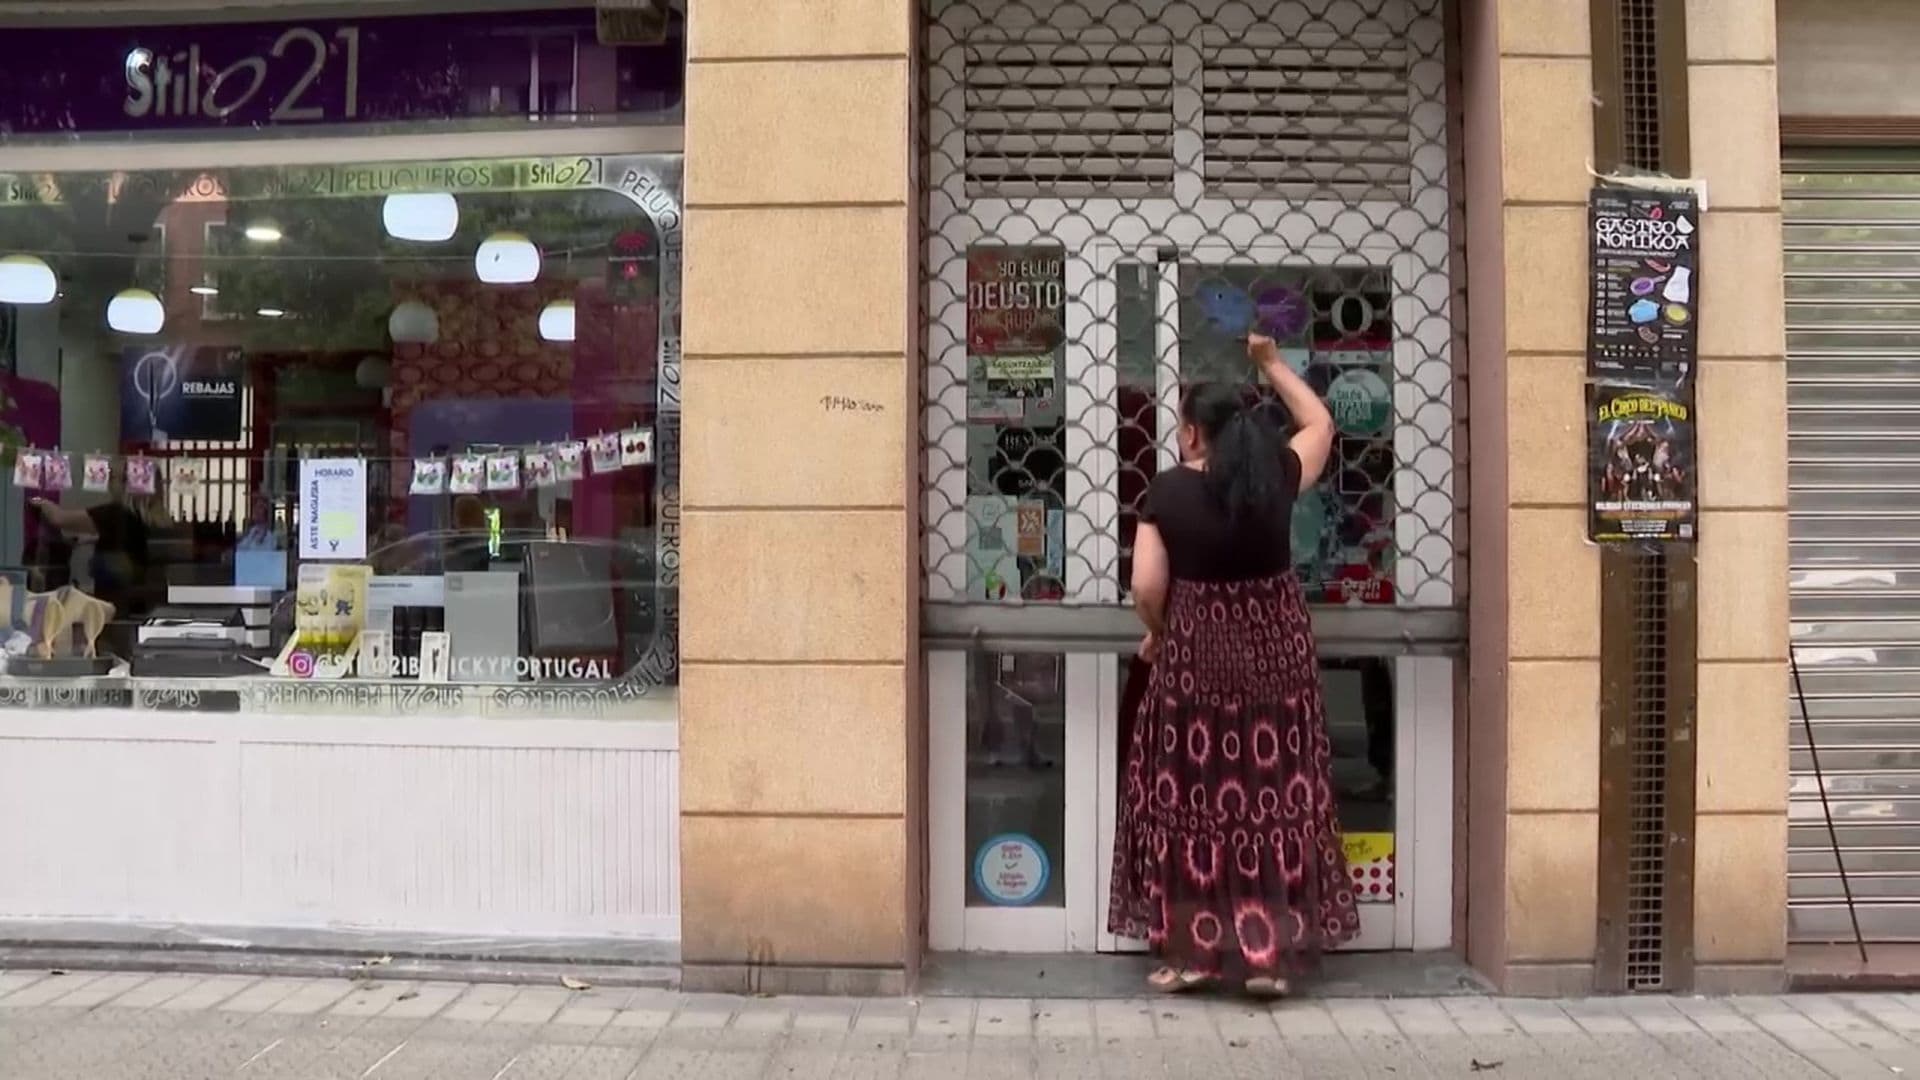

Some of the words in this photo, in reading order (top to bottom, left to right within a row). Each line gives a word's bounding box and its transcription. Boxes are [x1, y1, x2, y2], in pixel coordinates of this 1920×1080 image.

[345, 164, 490, 193] PELUQUEROS
[1596, 217, 1676, 235] GASTRO
[968, 281, 1061, 310] DEUSTO
[182, 381, 236, 394] REBAJAS
[314, 468, 354, 478] HORARIO
[308, 525, 318, 550] ASTE
